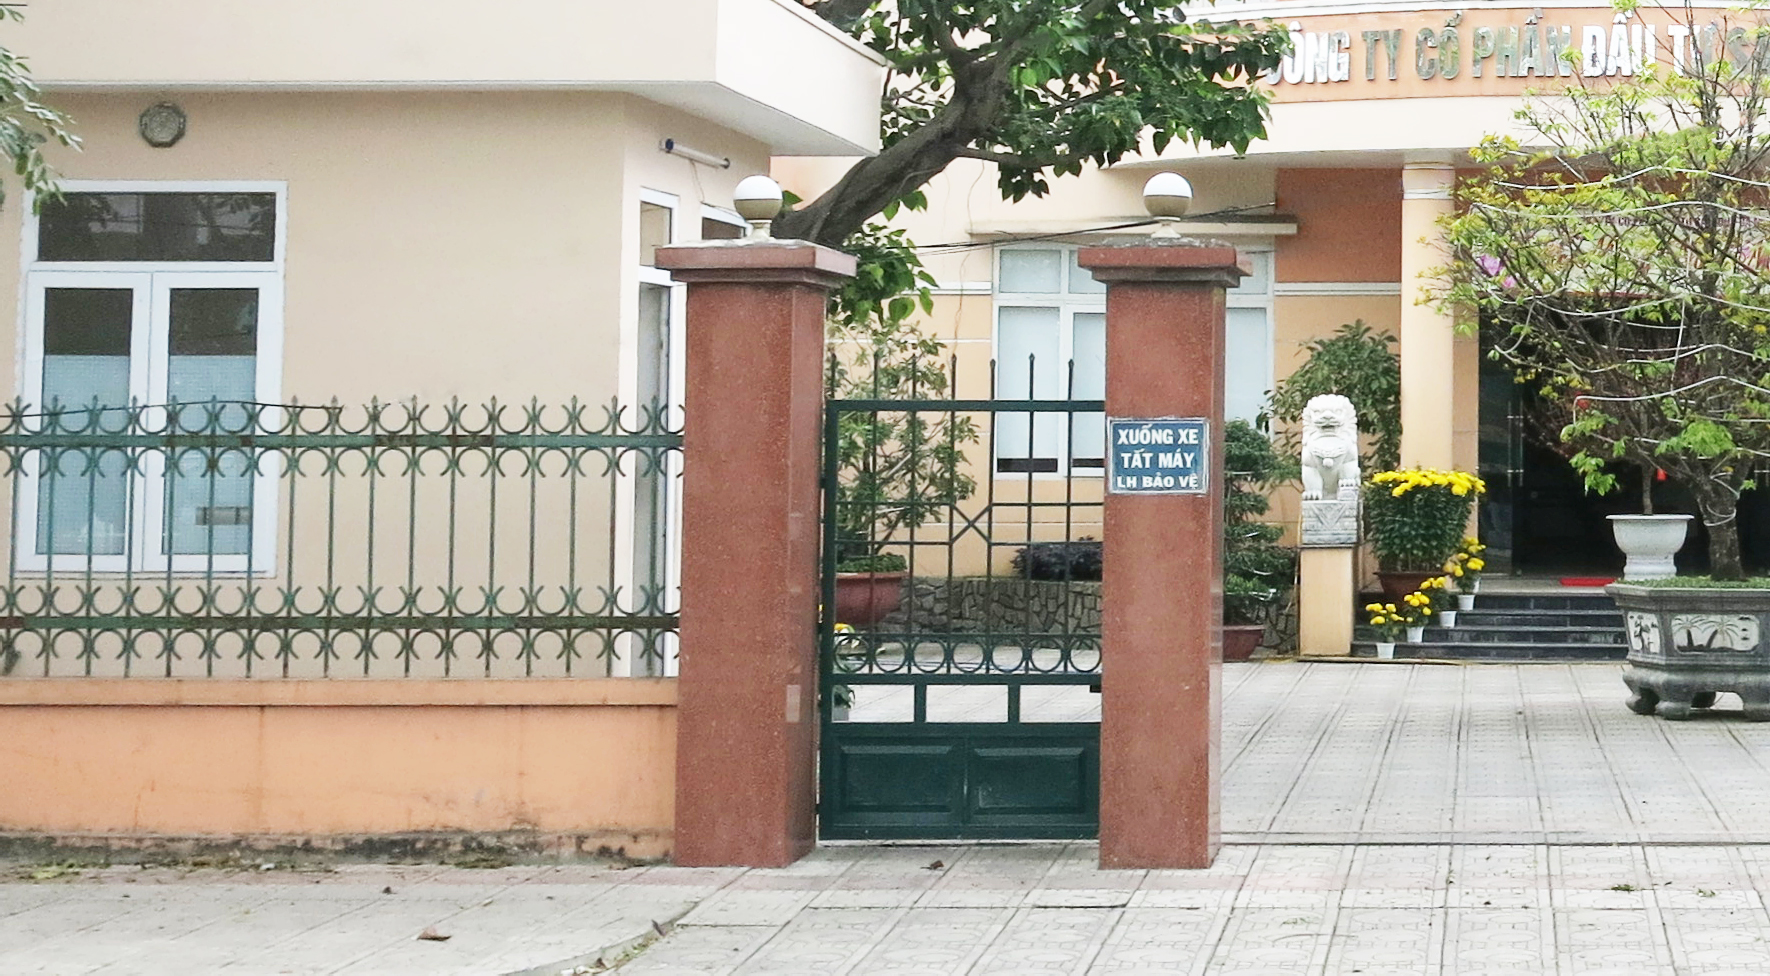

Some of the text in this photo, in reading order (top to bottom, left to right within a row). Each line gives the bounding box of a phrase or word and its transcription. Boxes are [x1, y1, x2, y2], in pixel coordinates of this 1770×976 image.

[1361, 28, 1402, 81] TY
[1415, 10, 1461, 81] CỔ
[1472, 8, 1572, 78] PHẦN
[1117, 424, 1198, 444] XUỐNG XE
[1121, 448, 1194, 468] TẮT MÁY
[1117, 472, 1198, 489] LH BẢO VỆ
